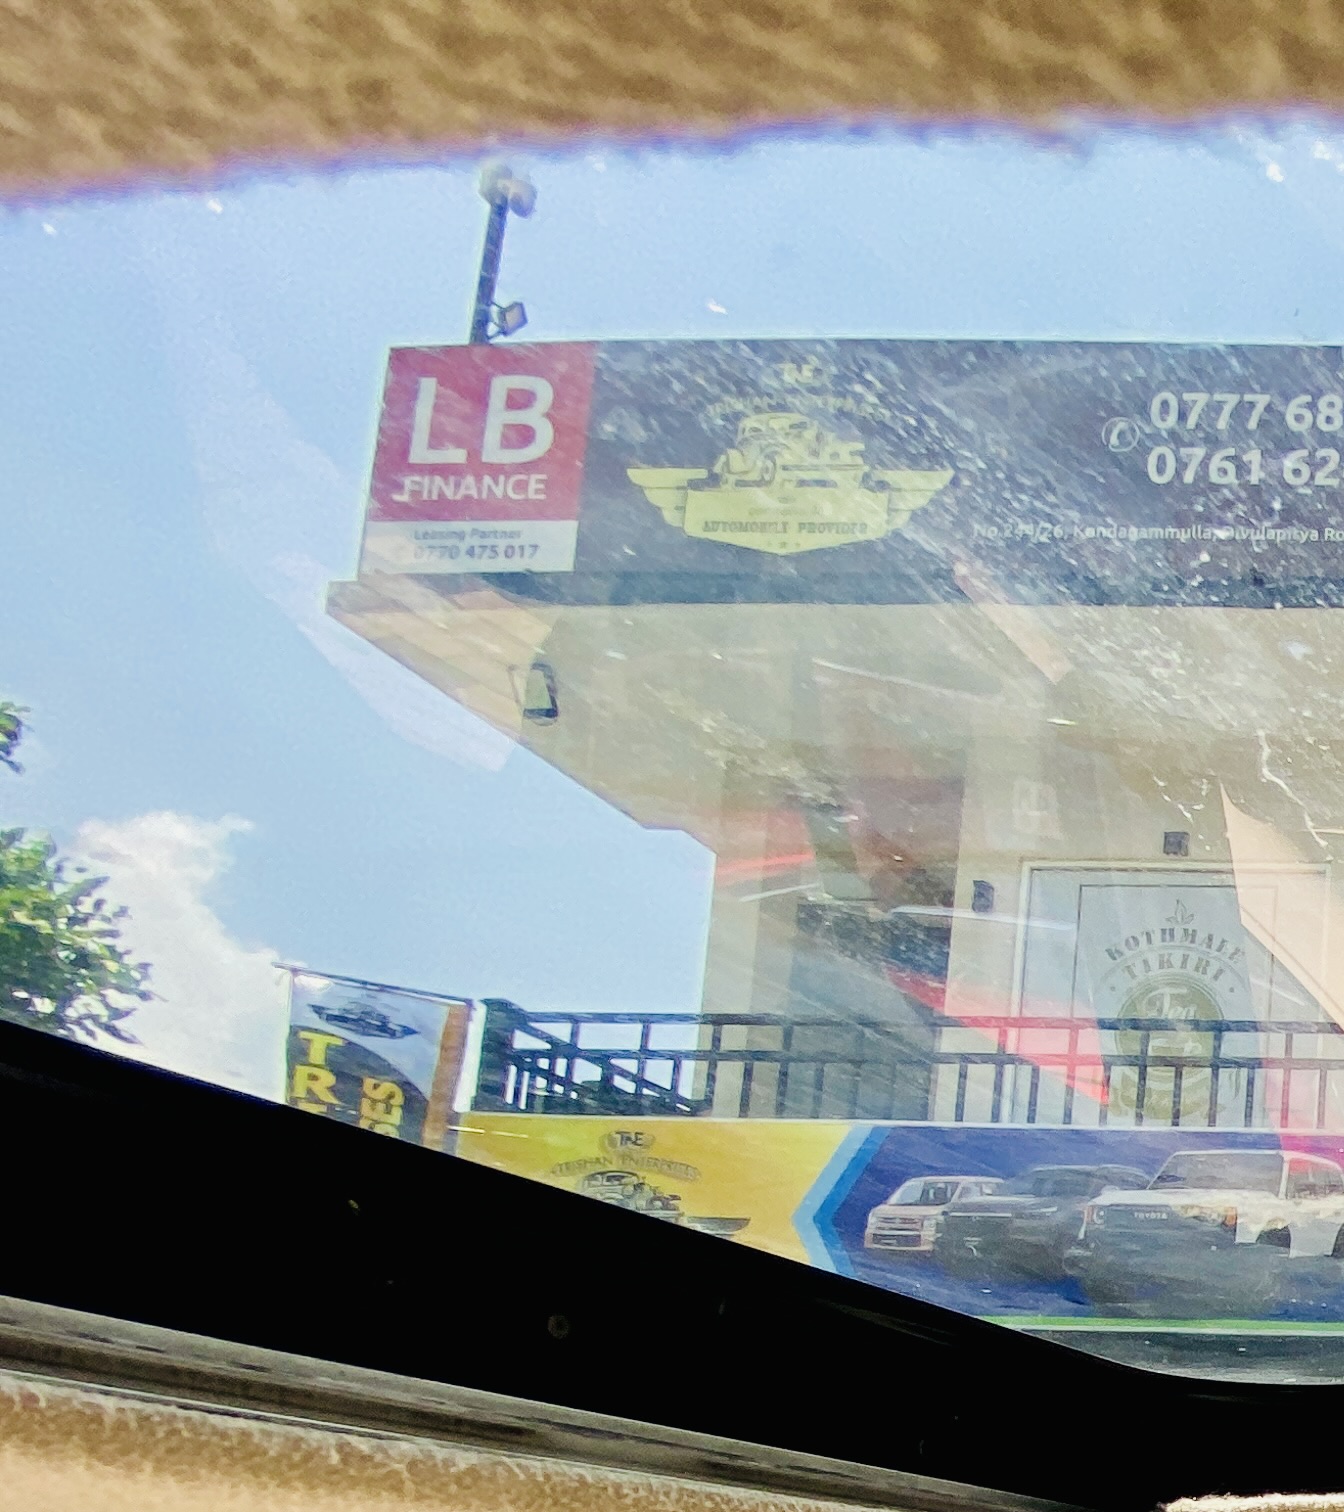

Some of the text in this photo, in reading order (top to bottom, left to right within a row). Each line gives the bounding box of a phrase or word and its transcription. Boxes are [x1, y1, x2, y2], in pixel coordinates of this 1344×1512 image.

[407, 374, 555, 465] LB
[1150, 391, 1271, 431] 0777
[1146, 445, 1264, 486] 0761
[401, 473, 549, 501] FINANCE
[465, 544, 500, 559] 475
[503, 543, 540, 560] 017
[1121, 953, 1227, 983] TIKIRI
